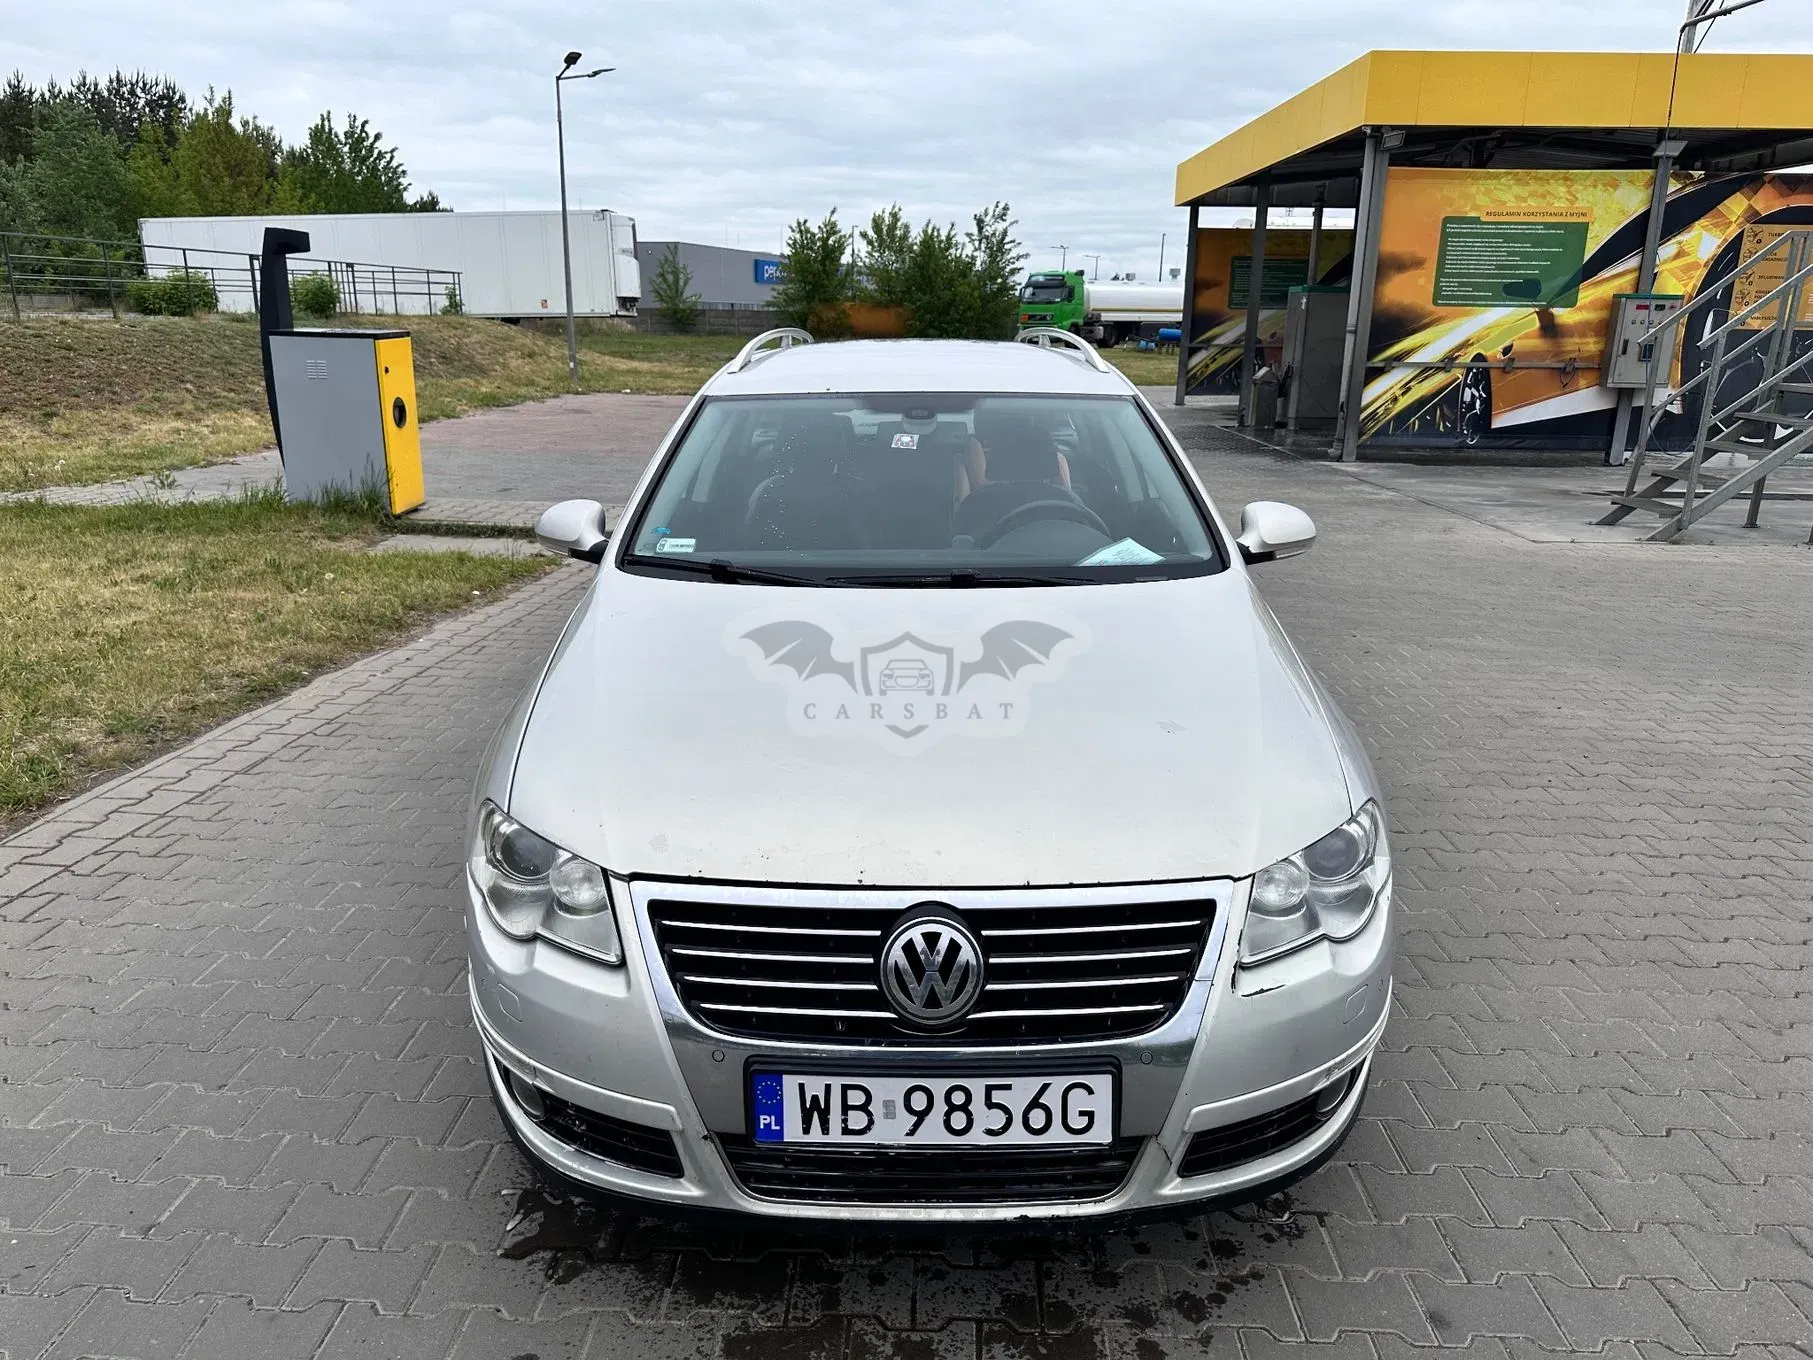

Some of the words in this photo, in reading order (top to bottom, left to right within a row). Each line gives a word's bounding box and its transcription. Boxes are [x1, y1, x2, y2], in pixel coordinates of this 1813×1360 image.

[759, 1115, 781, 1131] PL
[797, 1081, 875, 1136] WB
[902, 1081, 1096, 1137] 9856G
